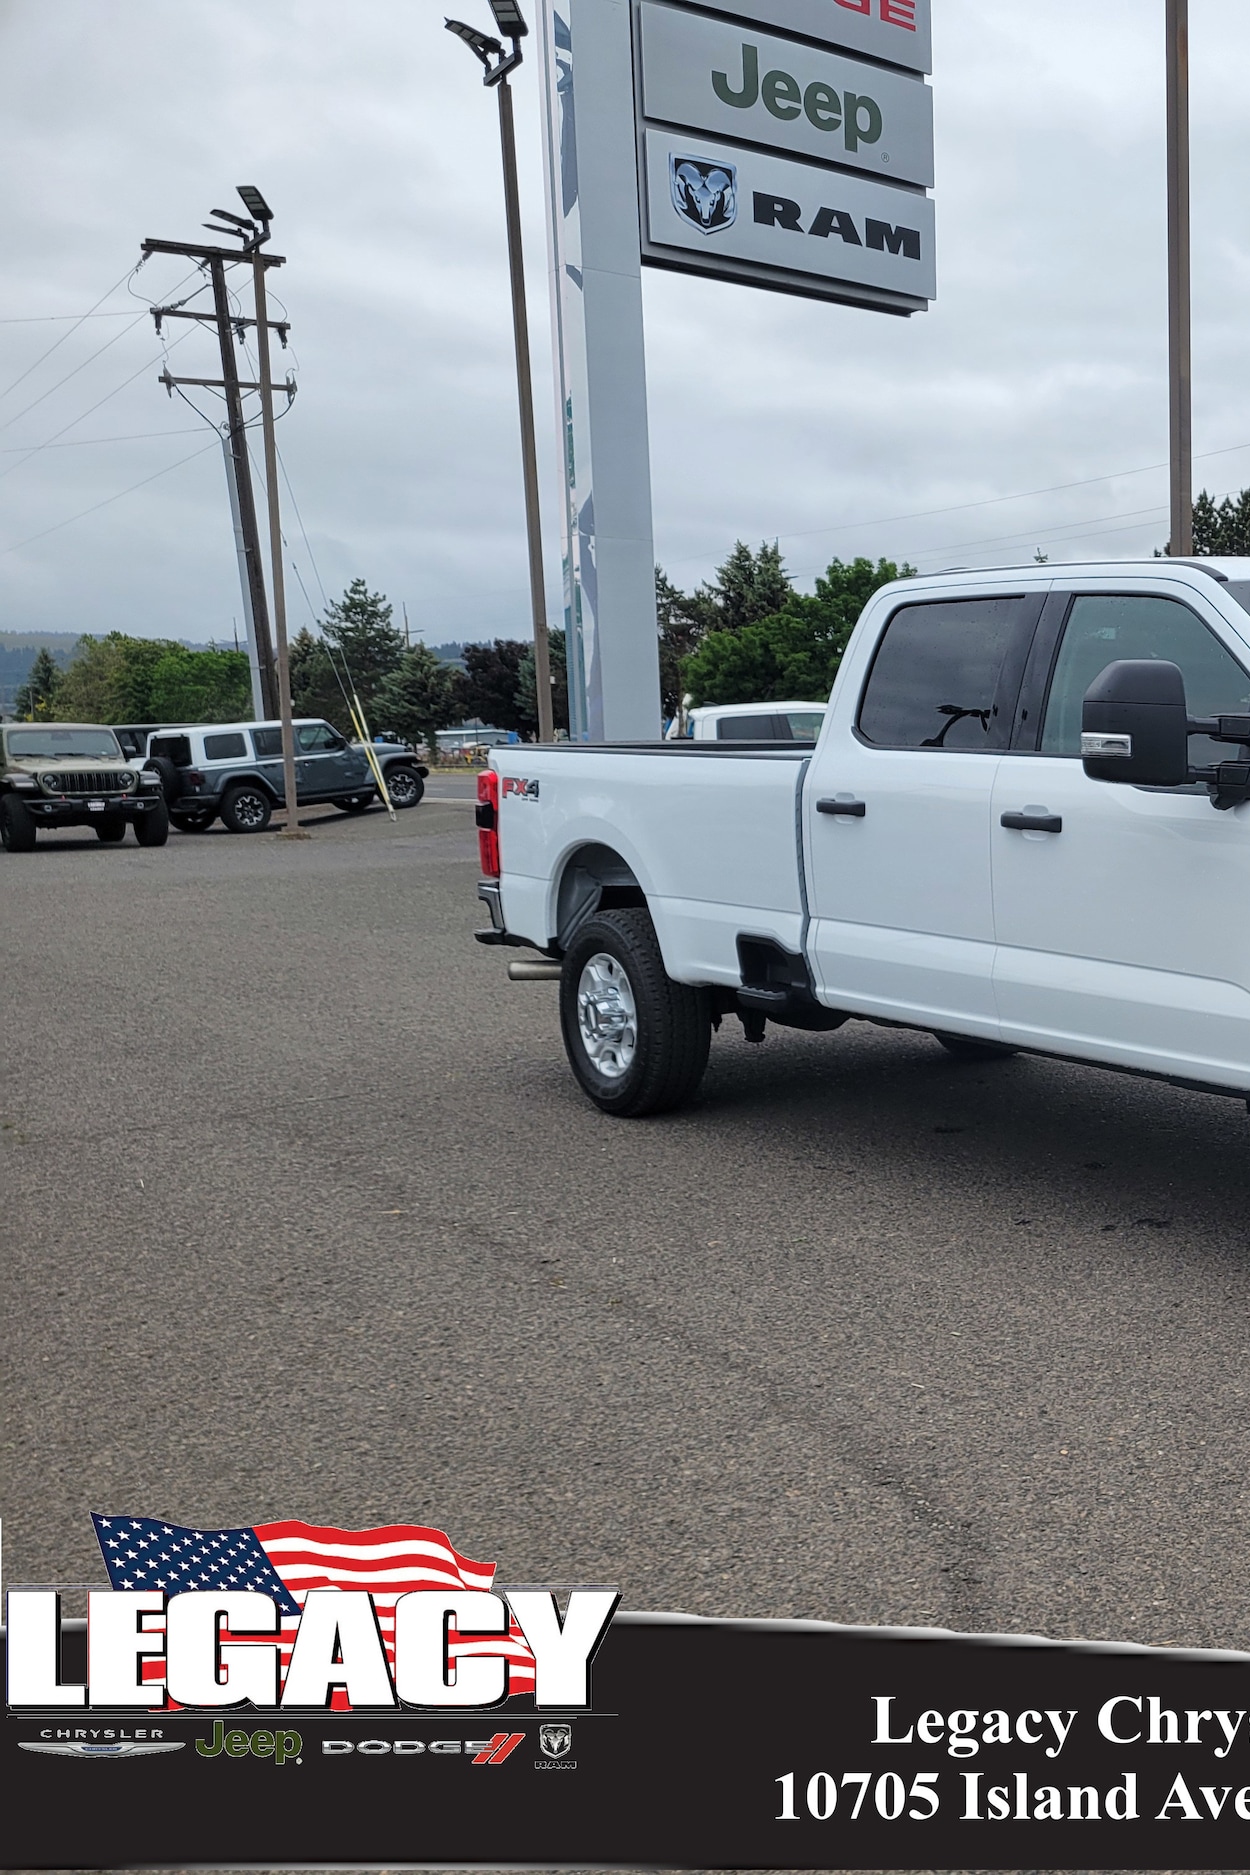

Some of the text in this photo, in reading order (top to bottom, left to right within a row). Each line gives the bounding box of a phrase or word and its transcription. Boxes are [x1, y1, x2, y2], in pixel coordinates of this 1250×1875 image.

[711, 43, 883, 152] Jeep
[753, 191, 921, 261] RAM
[502, 776, 539, 799] FX4
